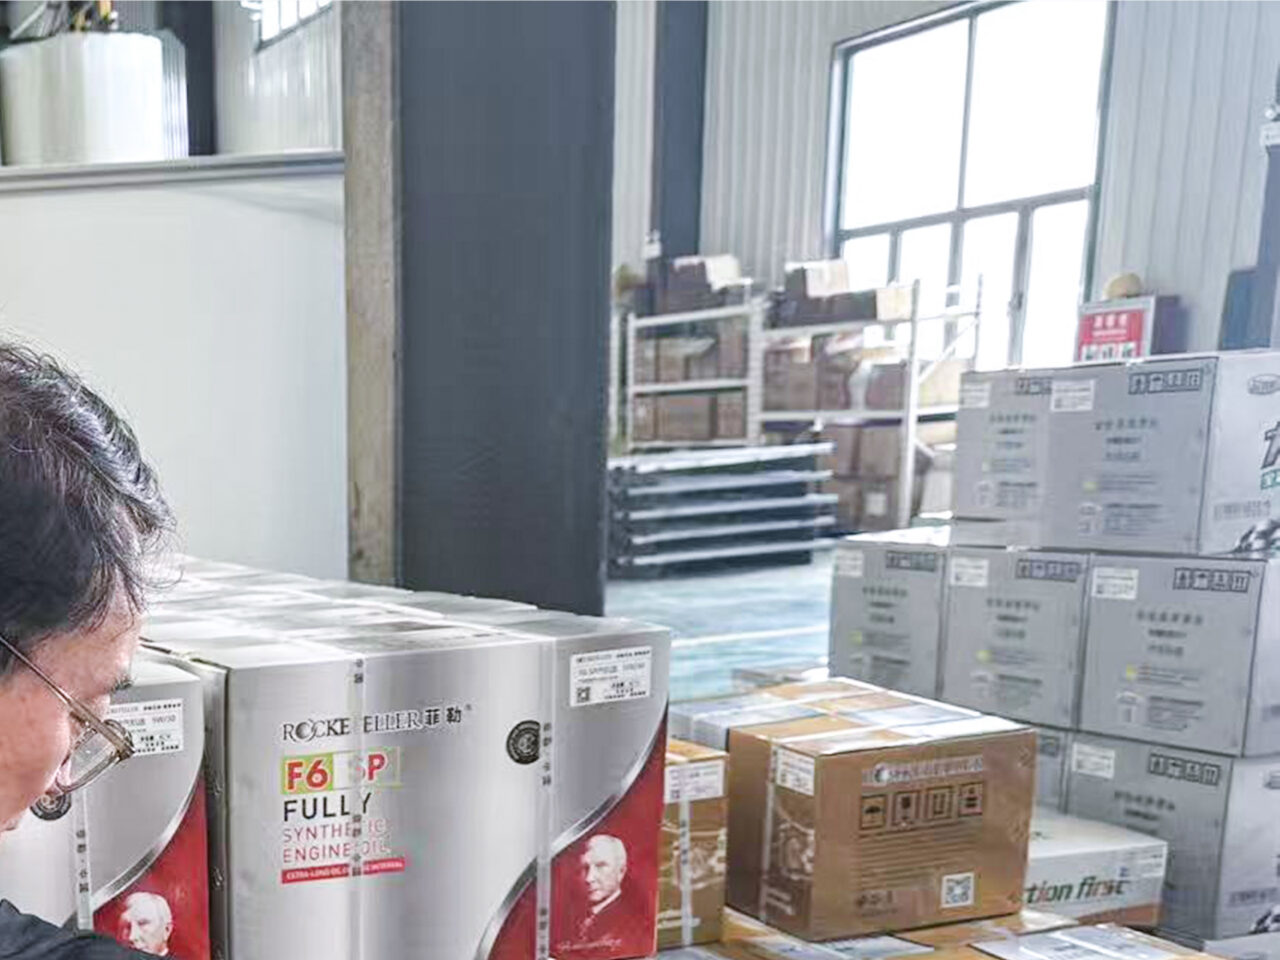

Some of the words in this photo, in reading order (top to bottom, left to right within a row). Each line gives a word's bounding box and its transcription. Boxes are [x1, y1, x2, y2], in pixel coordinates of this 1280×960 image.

[282, 713, 421, 741] ROCKEELLER
[286, 758, 329, 791] F6
[283, 792, 372, 822] FULLY
[283, 818, 387, 843] SYNTHEIC
[283, 843, 351, 863] ENGINE
